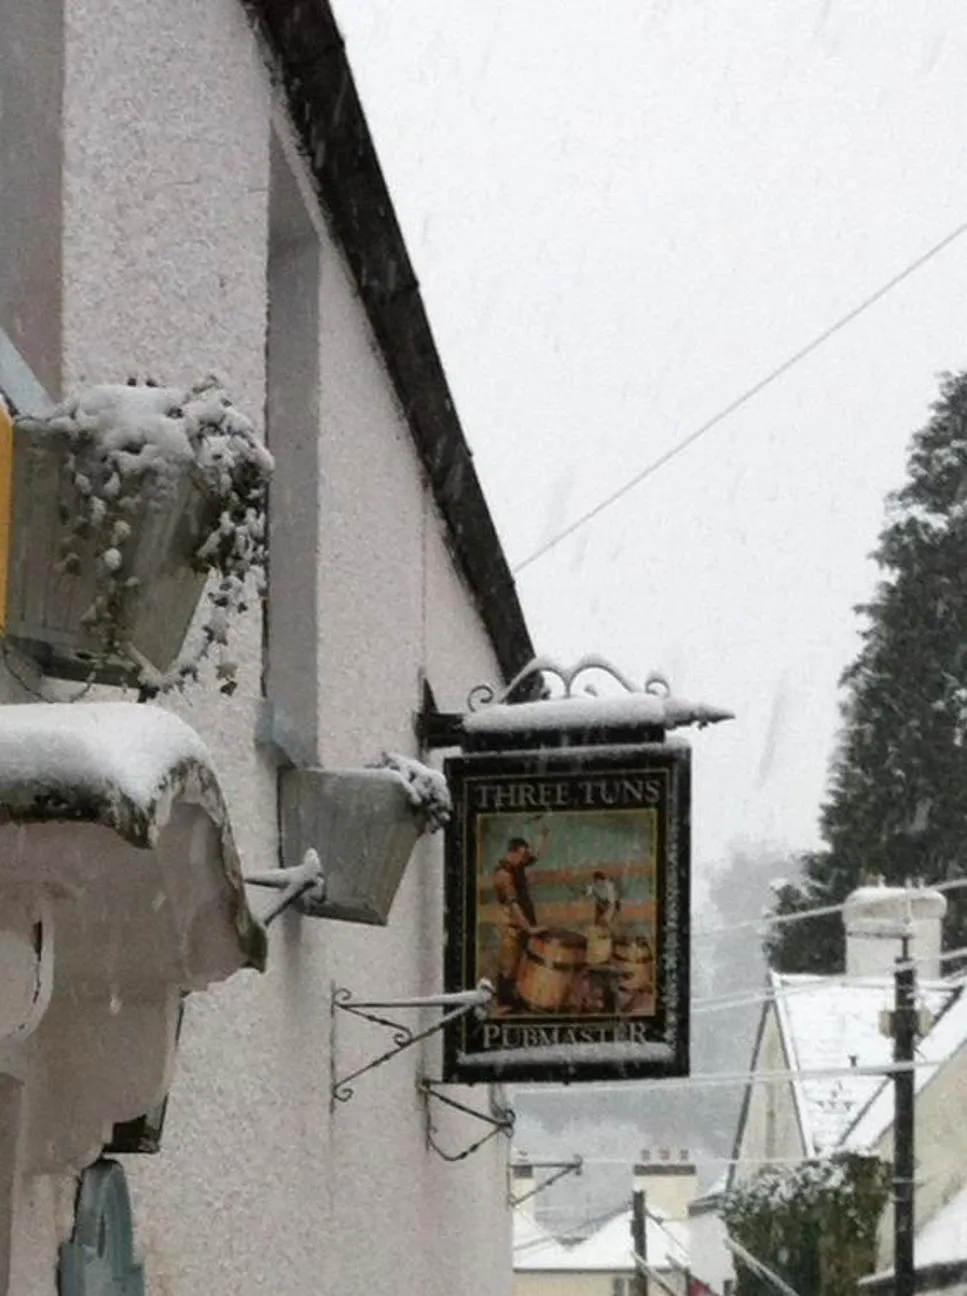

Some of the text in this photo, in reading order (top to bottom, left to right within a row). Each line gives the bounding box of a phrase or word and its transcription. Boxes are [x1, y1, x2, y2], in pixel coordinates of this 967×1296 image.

[474, 778, 663, 808] THREE TUNS
[482, 1022, 648, 1049] PUBMASTER
